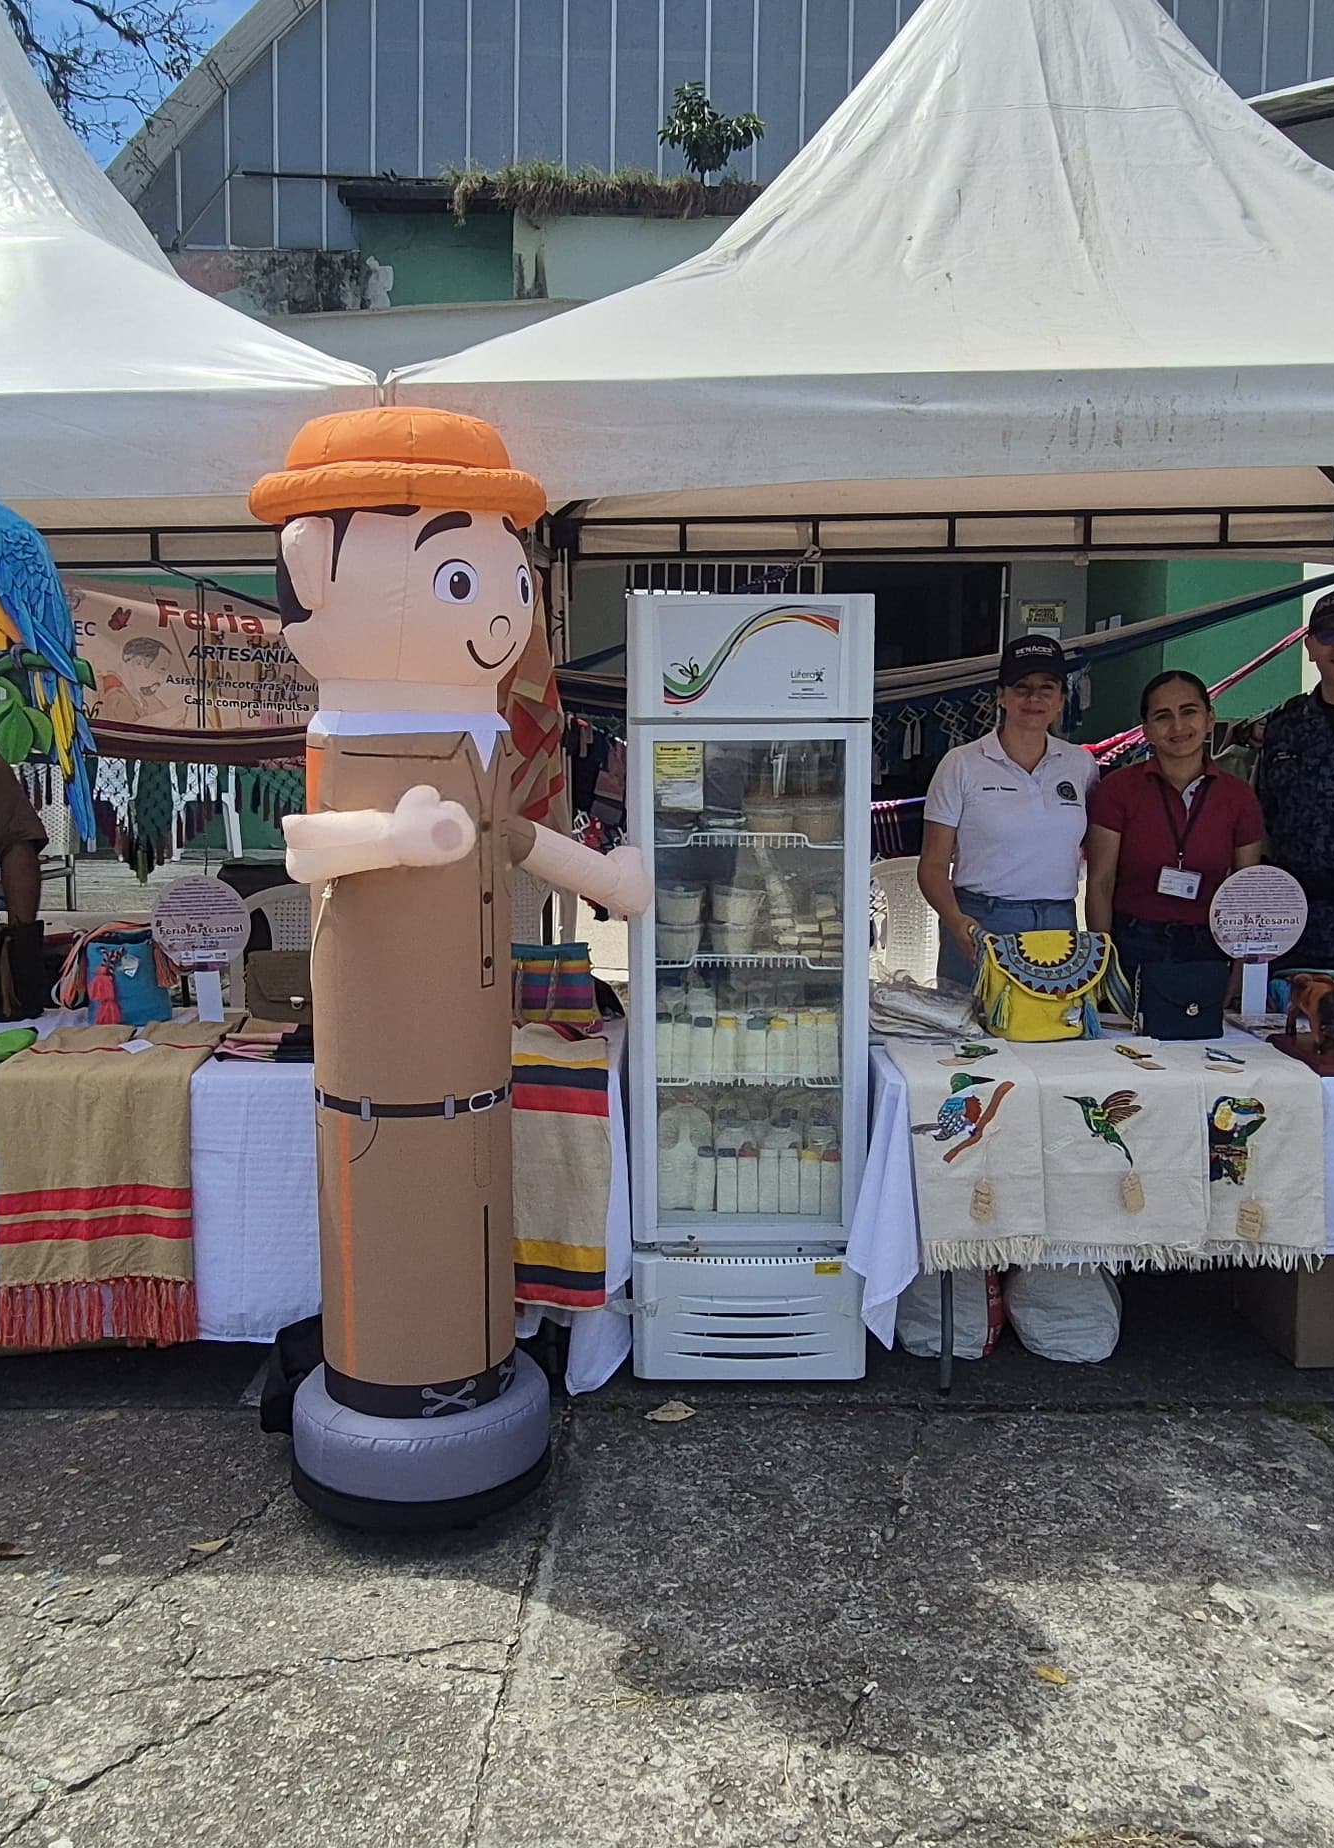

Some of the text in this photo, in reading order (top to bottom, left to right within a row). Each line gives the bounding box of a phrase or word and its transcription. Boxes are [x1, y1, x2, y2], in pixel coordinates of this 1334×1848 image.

[155, 598, 265, 636] Feria
[284, 681, 318, 693] fabul
[183, 694, 213, 707] Caa
[216, 698, 259, 710] compra
[262, 699, 310, 713] impulsa
[1246, 915, 1300, 926] Artesanal
[189, 924, 244, 935] Artesanal
